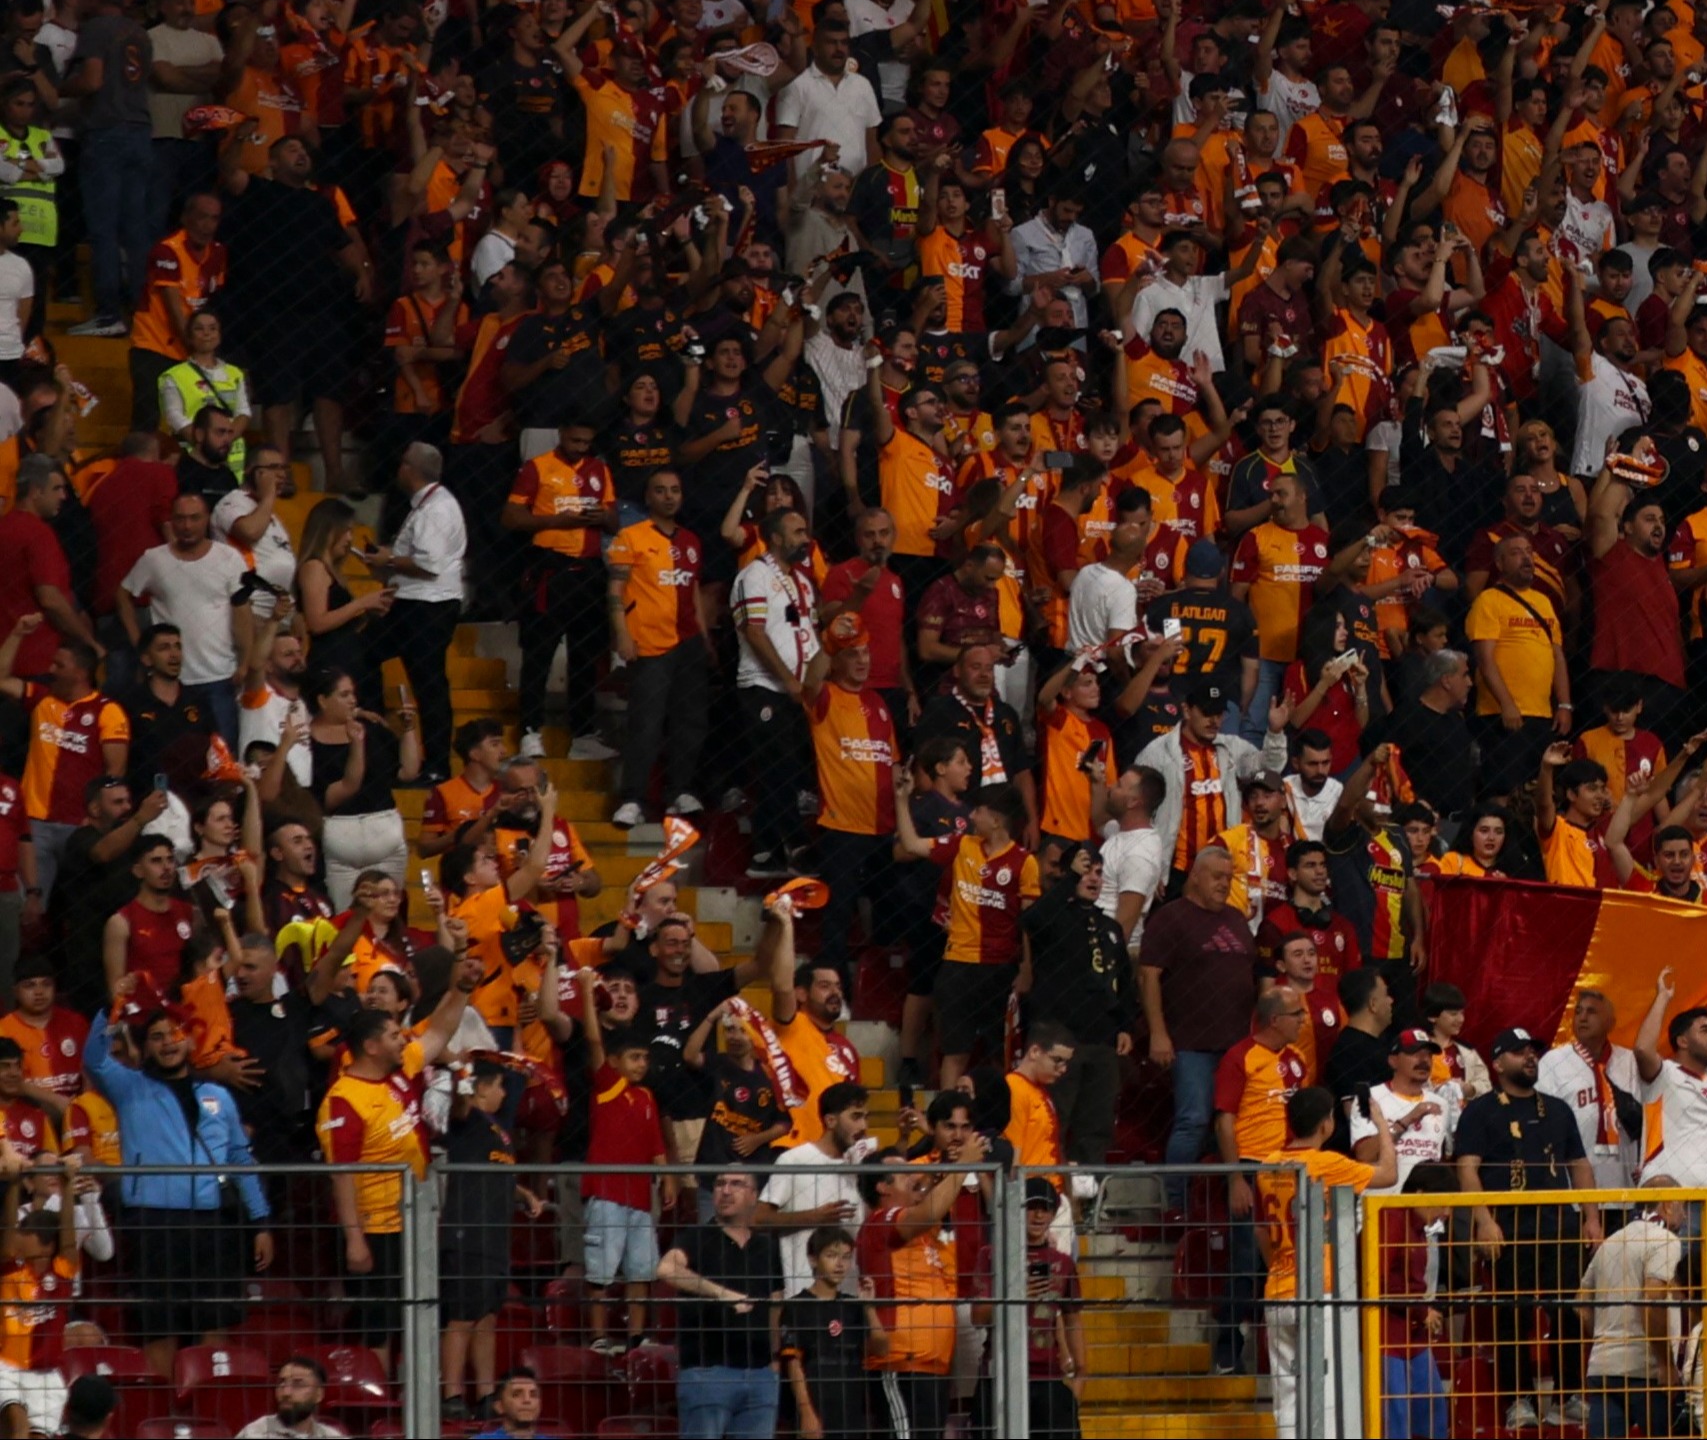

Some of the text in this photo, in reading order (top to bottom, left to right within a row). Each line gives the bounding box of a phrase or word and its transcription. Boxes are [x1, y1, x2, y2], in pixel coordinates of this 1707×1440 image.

[947, 261, 983, 280] SIXT
[922, 473, 953, 496] SIXT
[657, 568, 692, 586] SIXT
[1190, 778, 1221, 795] SIXT
